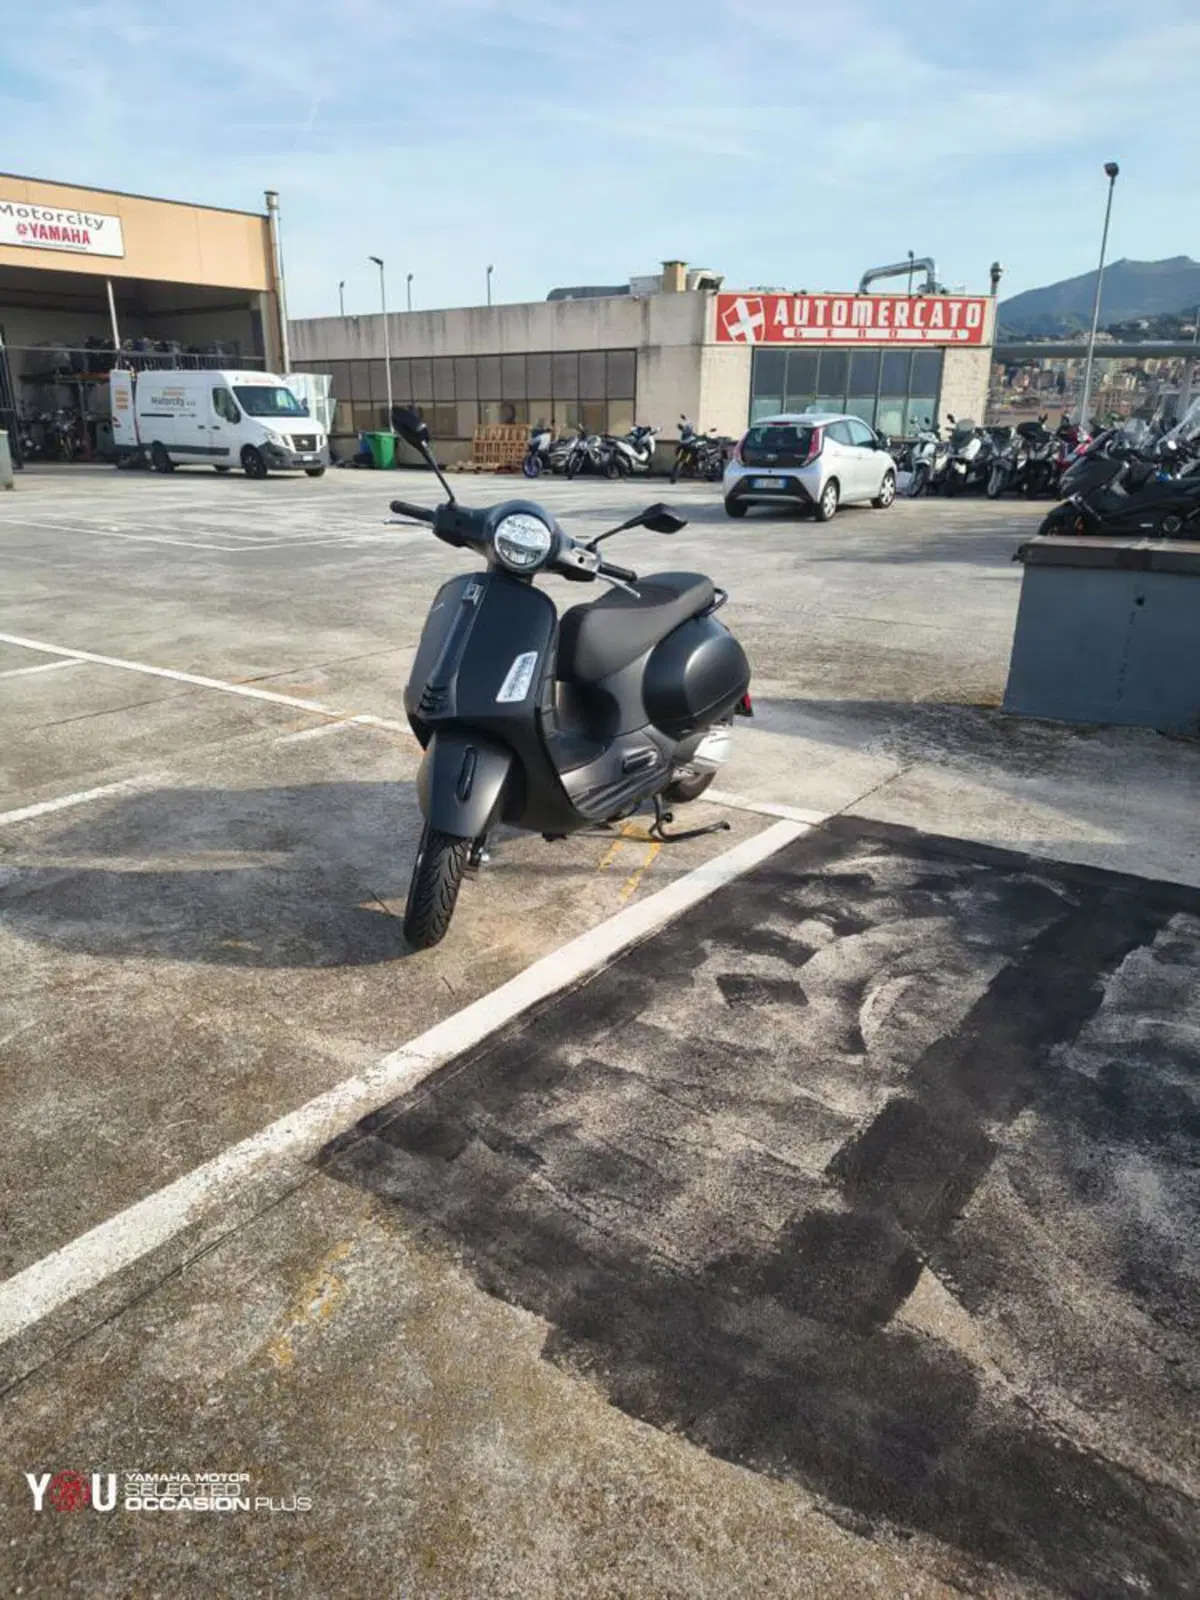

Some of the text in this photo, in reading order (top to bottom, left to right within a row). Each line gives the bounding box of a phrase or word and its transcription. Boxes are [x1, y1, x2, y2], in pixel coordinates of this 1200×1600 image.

[0, 204, 104, 230] Motorcity
[29, 223, 91, 244] YAMAHA
[773, 299, 982, 327] AUTOMERCATO
